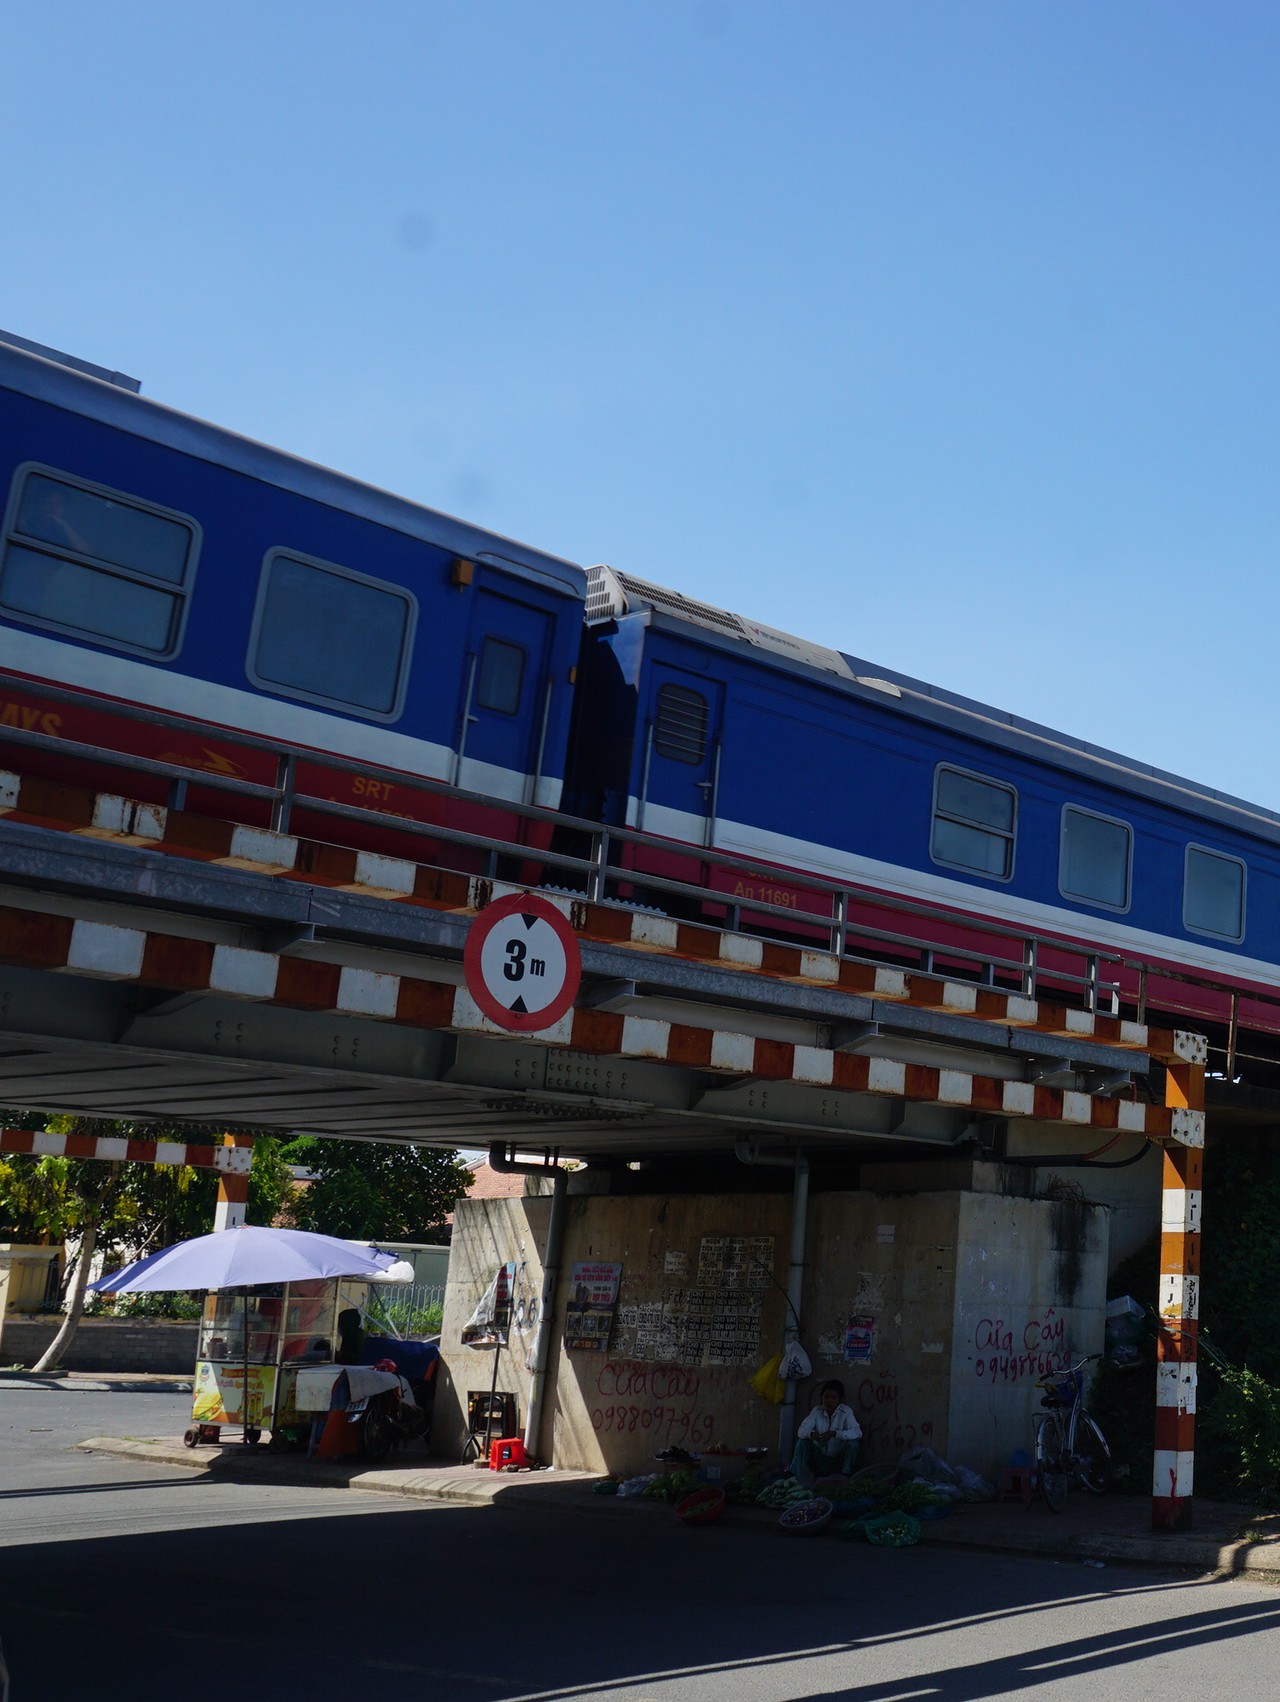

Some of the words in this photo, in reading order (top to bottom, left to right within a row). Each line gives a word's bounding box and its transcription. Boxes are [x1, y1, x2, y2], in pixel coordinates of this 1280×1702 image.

[0, 702, 64, 736] AYS
[352, 776, 395, 801] SRT
[734, 881, 754, 899] An
[758, 887, 798, 909] 11691
[592, 1406, 714, 1445] 0988097969
